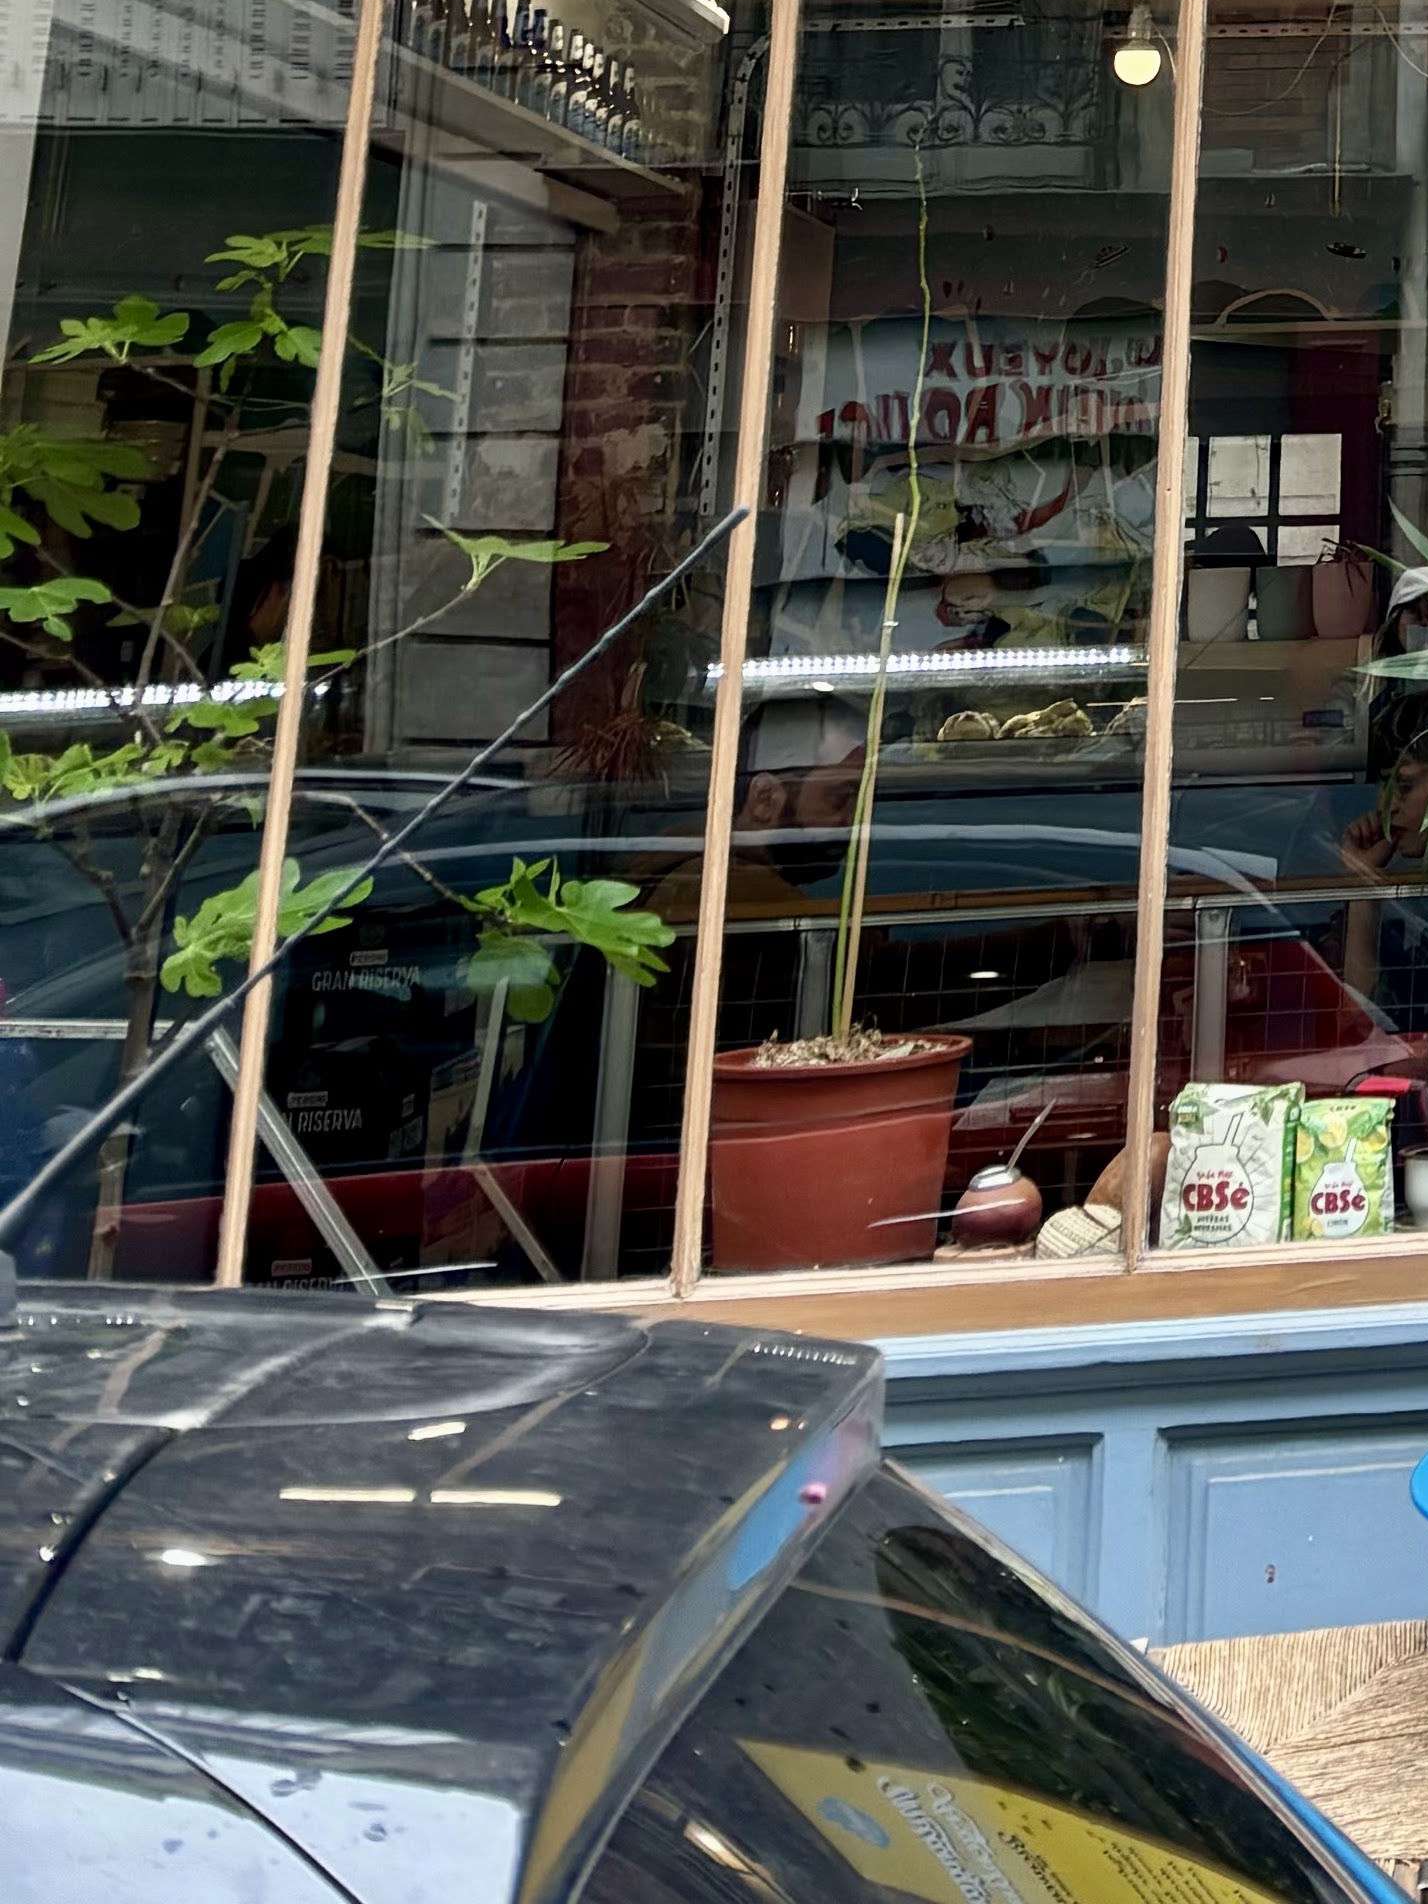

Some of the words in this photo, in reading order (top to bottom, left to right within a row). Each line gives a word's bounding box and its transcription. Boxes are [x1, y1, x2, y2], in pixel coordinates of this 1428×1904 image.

[297, 1106, 364, 1134] RISERVA
[1182, 1180, 1250, 1212] CBSé
[1310, 1188, 1367, 1216] CBSé
